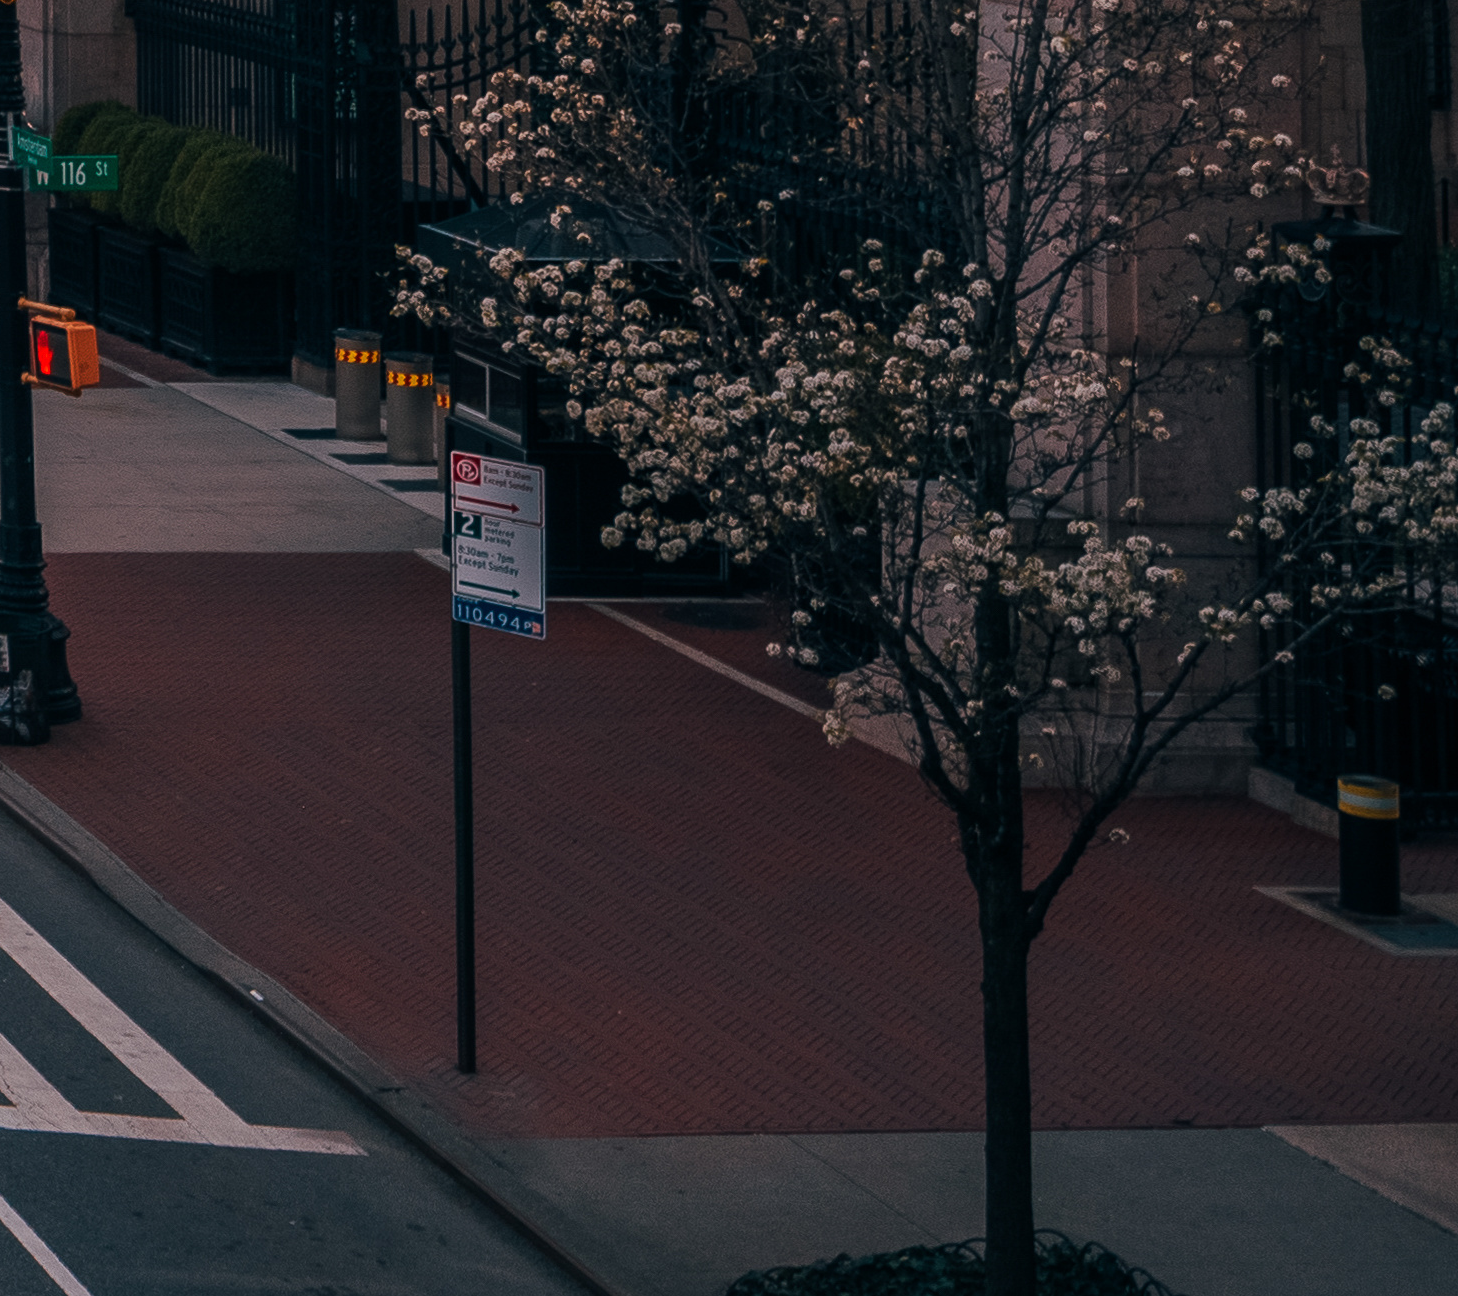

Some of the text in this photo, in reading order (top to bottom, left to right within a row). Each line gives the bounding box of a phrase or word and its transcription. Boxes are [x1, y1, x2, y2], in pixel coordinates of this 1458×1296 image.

[60, 161, 86, 185] 116
[95, 160, 108, 177] St
[483, 476, 534, 493] Except Sunday
[461, 513, 475, 535] 2
[485, 527, 515, 539] metered
[485, 536, 511, 547] parking
[458, 544, 489, 558] 8:30am
[497, 553, 515, 564] 7pm
[458, 555, 520, 577] Except Sunday
[457, 603, 520, 631] 110494
